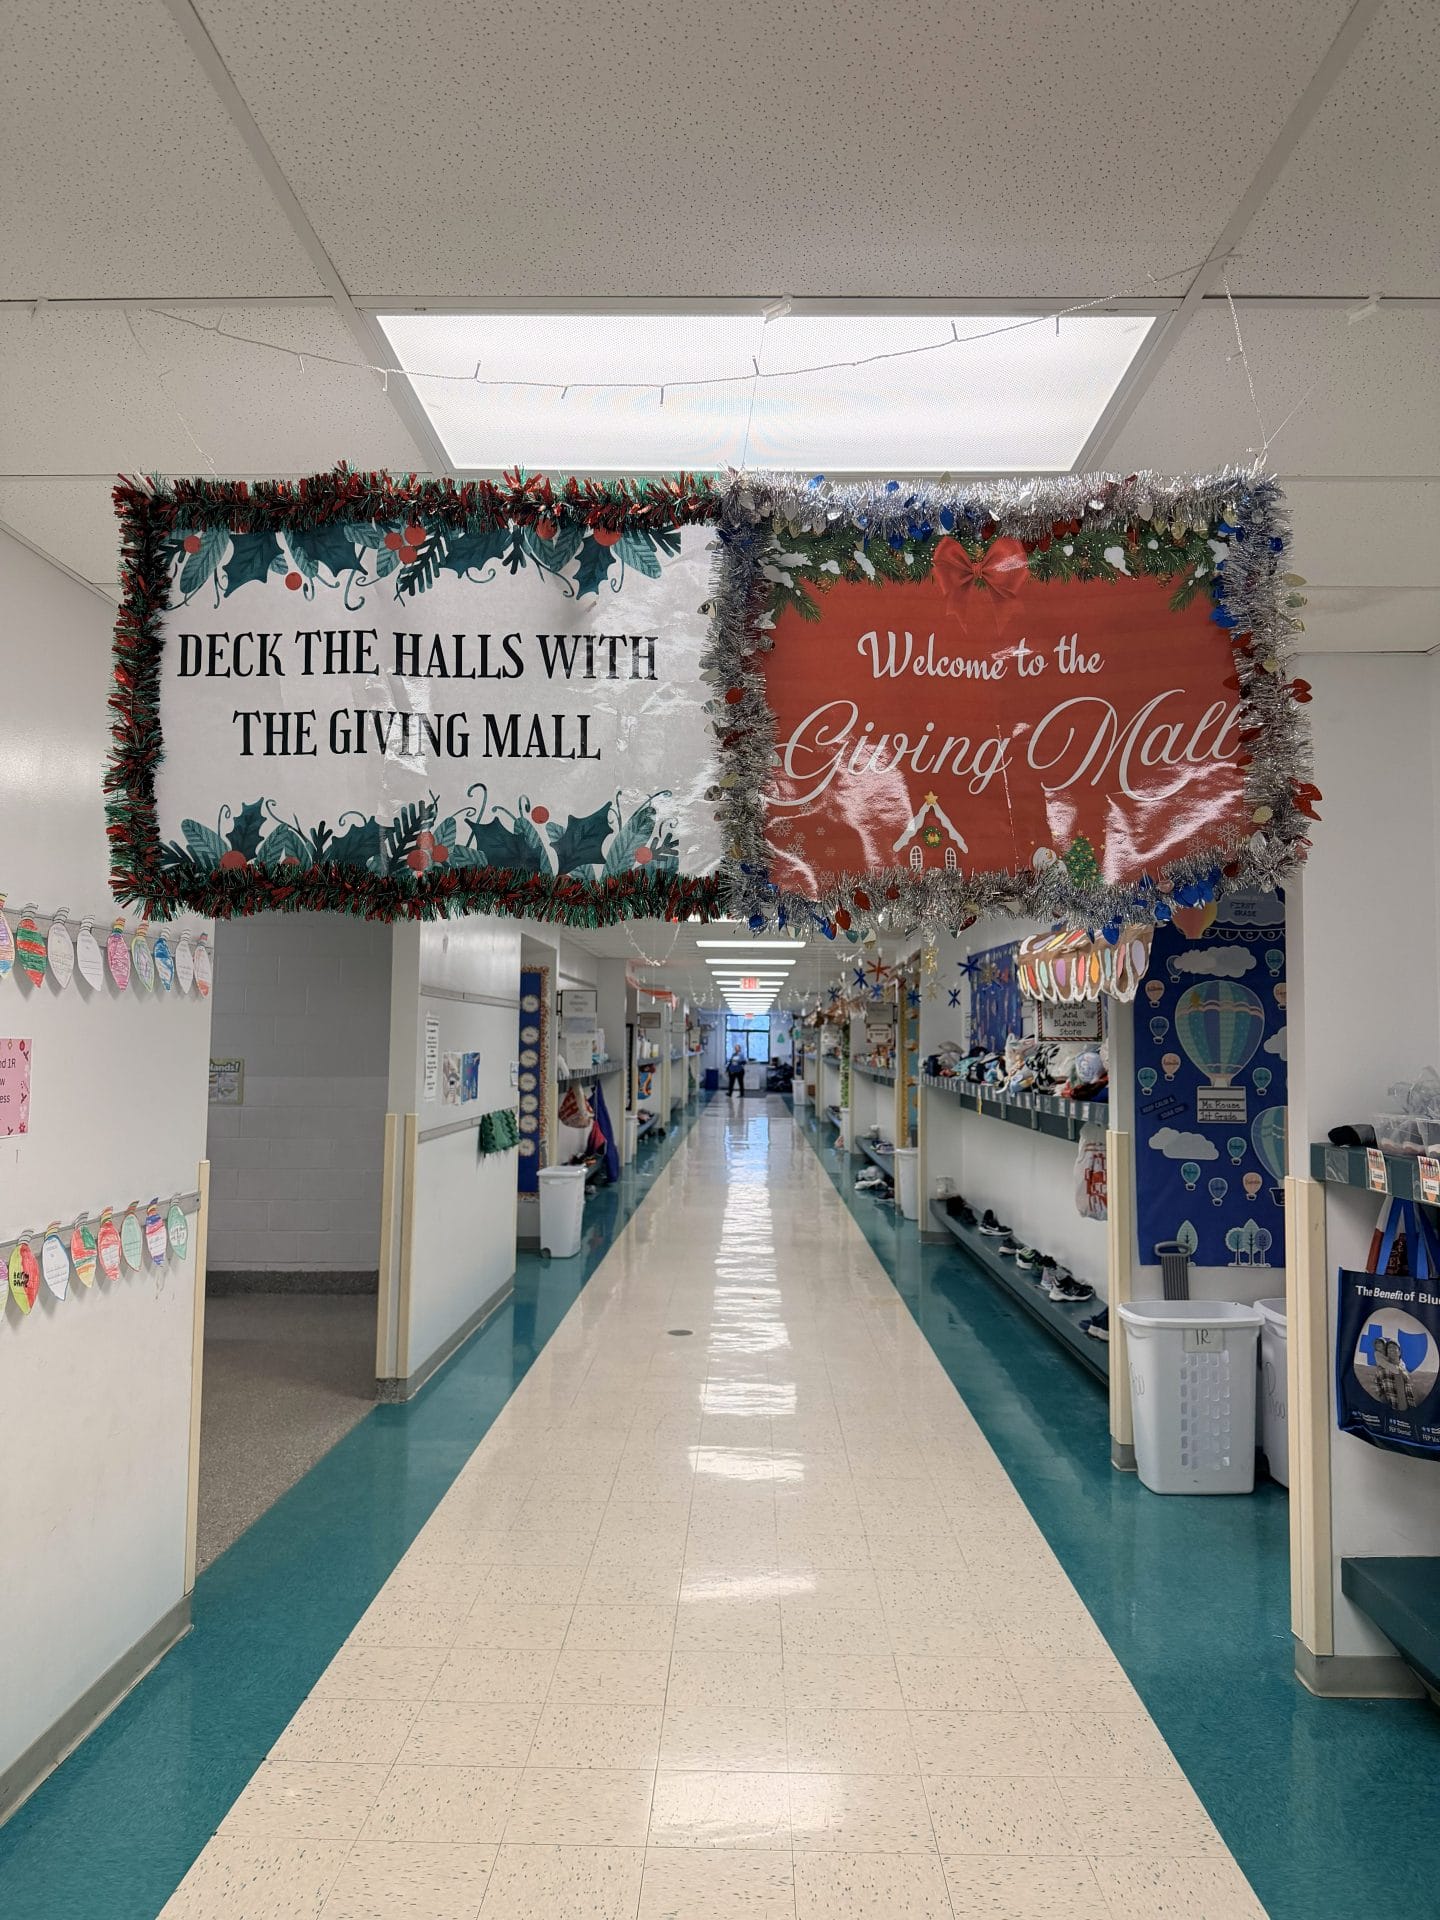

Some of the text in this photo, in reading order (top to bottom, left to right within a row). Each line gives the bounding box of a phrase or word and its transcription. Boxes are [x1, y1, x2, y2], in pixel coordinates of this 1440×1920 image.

[176, 628, 659, 681] DECK THE HALLS WITH
[857, 631, 1105, 680] Welcome to the
[232, 708, 602, 761] THE GIVING MALL
[765, 689, 1242, 806] Giving Mall
[1355, 1285, 1440, 1305] The Benefit of Blu
